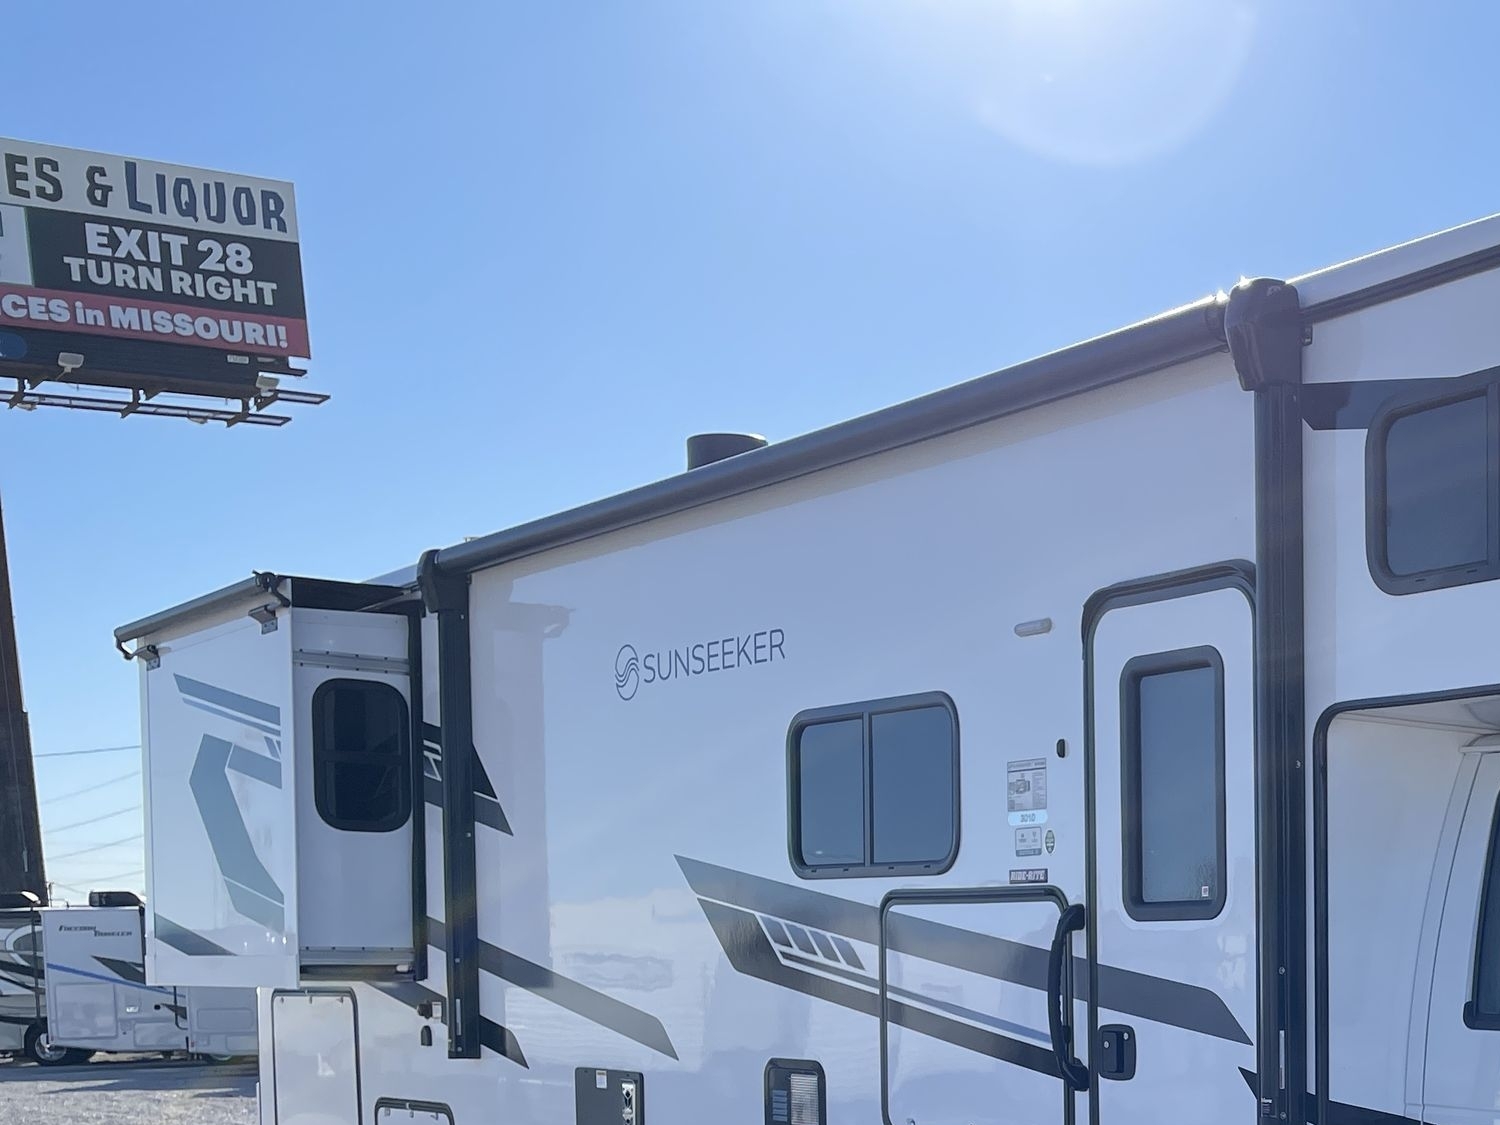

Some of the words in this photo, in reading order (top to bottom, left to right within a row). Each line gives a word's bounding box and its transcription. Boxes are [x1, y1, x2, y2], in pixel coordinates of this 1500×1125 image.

[4, 152, 63, 202] ES
[85, 165, 113, 208] &
[124, 160, 288, 234] LIQUOR
[84, 222, 189, 266] EXIT
[197, 239, 254, 275] 28
[63, 256, 163, 292] TURN
[170, 269, 278, 306] RIGHT
[75, 300, 105, 327] in
[110, 304, 289, 349] MISSOURI!
[643, 628, 786, 684] SUNSEEKER
